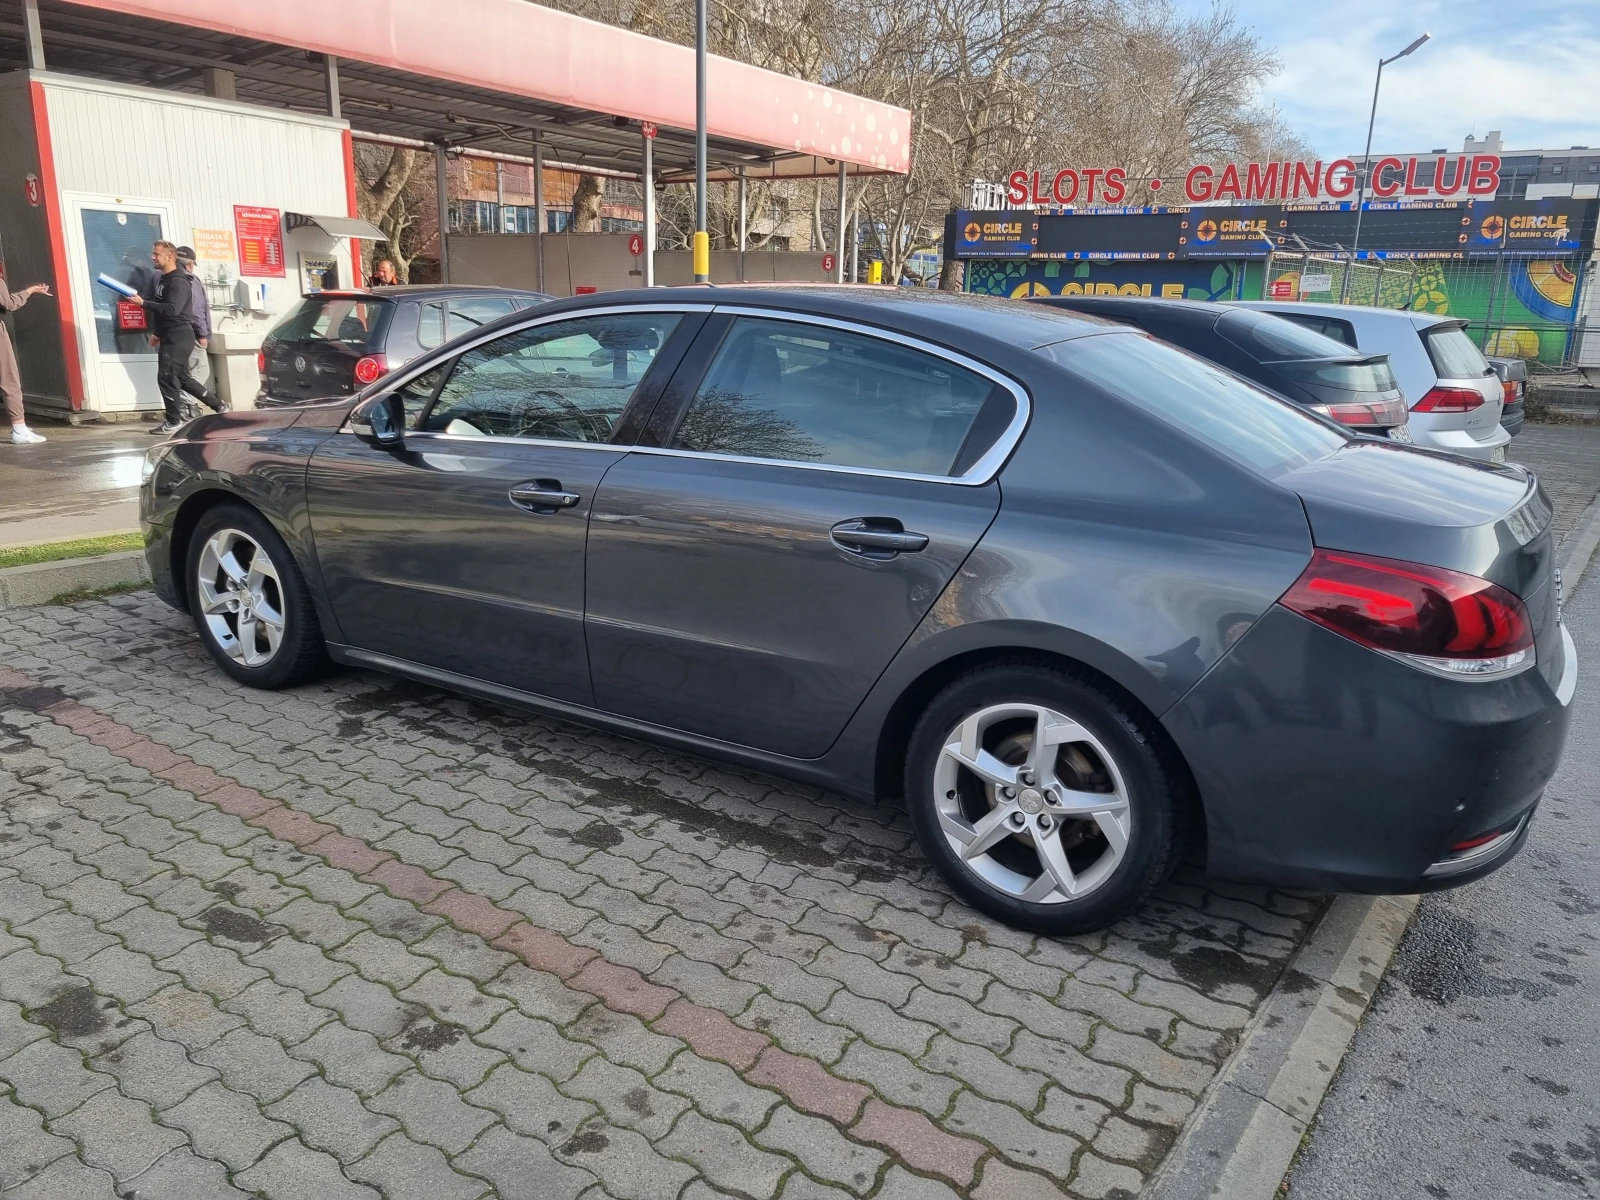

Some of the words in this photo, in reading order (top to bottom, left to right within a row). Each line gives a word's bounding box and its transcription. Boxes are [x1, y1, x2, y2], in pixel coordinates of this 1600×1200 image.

[1007, 167, 1126, 205] SLOTS
[1185, 158, 1357, 202] GAMING
[1371, 154, 1501, 198] CLUB
[29, 180, 37, 202] 3
[1319, 203, 1340, 211] CLUB
[1400, 201, 1433, 209] GAMING
[1435, 201, 1458, 209] CLUB
[1072, 208, 1096, 216] CIRCLE
[983, 222, 1023, 234] CIRCLE
[1220, 219, 1267, 232] CIRCLE
[1509, 215, 1568, 229] CIRCLE
[632, 238, 639, 254] 4
[825, 257, 832, 270] 5
